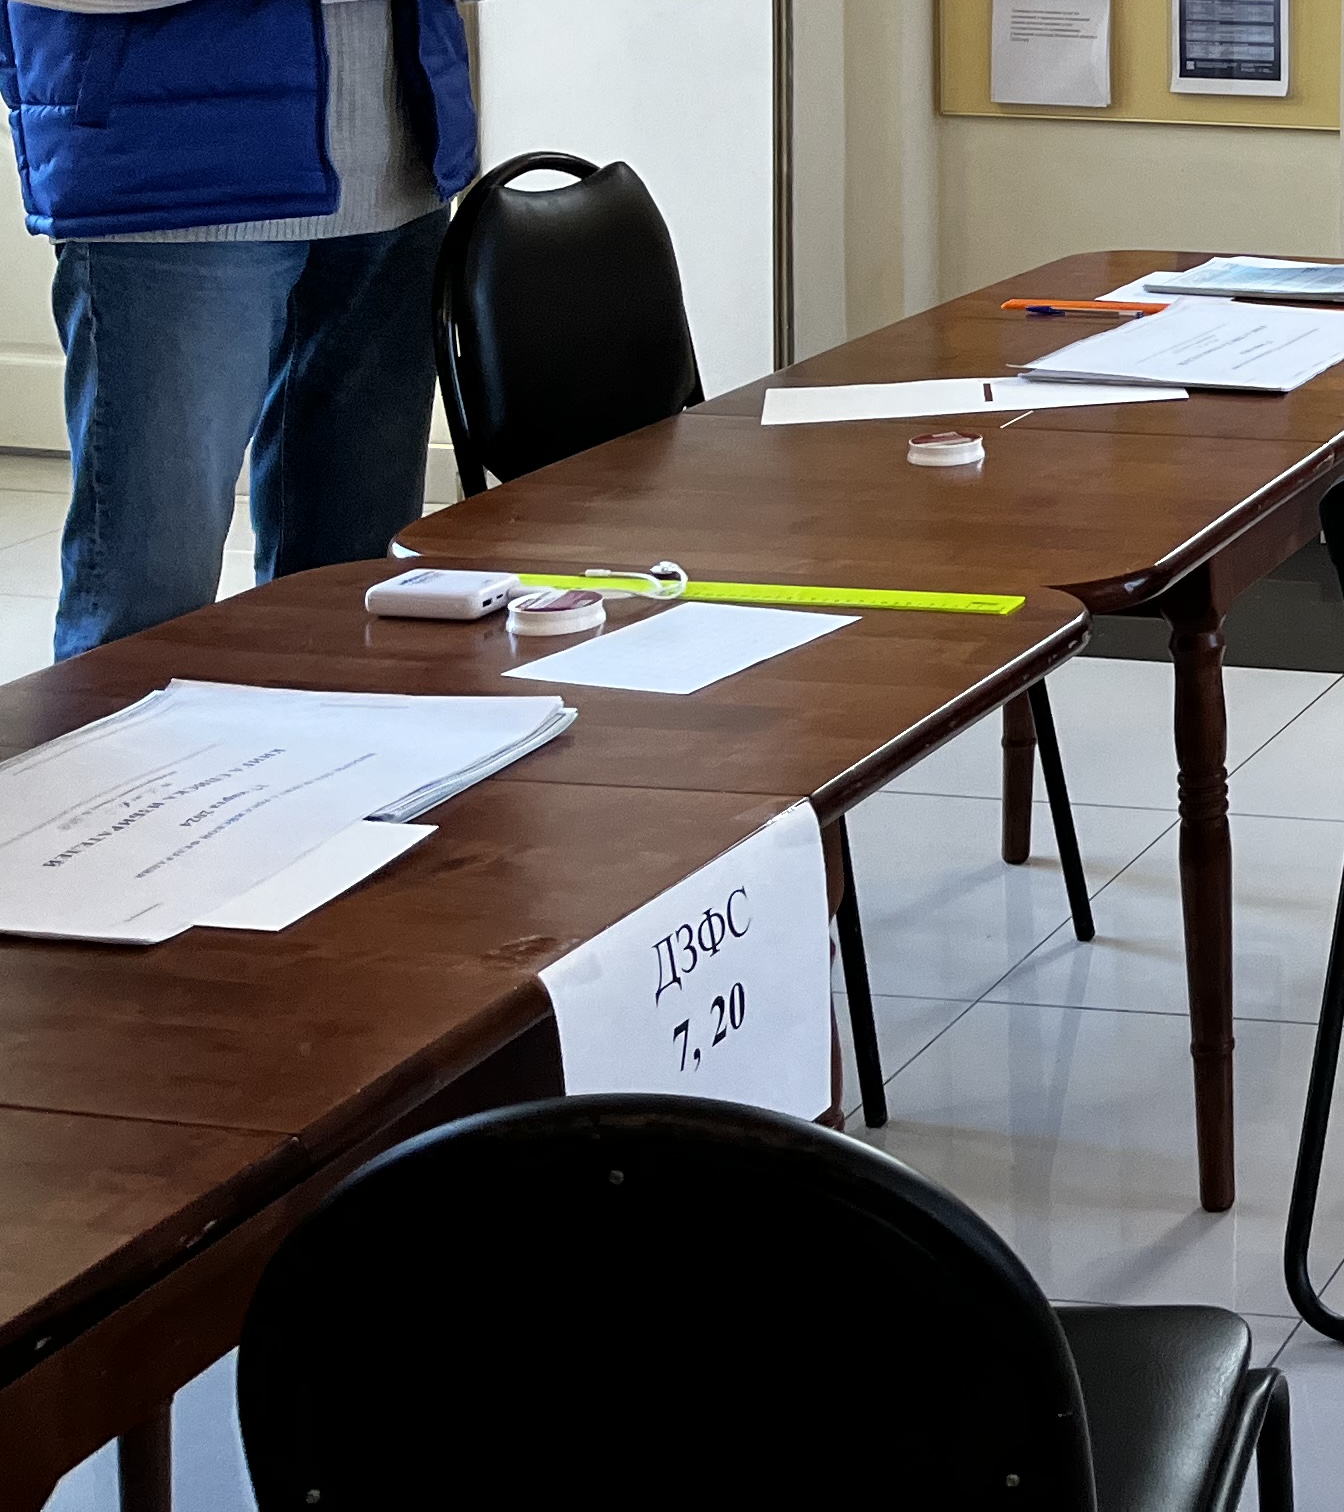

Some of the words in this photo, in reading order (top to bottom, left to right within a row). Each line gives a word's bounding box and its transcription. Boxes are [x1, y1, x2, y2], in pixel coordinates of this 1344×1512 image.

[42, 800, 166, 868] ИЗБИРАТЕЛЕЙ
[651, 885, 752, 1008] ДЗФС
[672, 1017, 702, 1073] 7,
[709, 981, 746, 1048] 20
